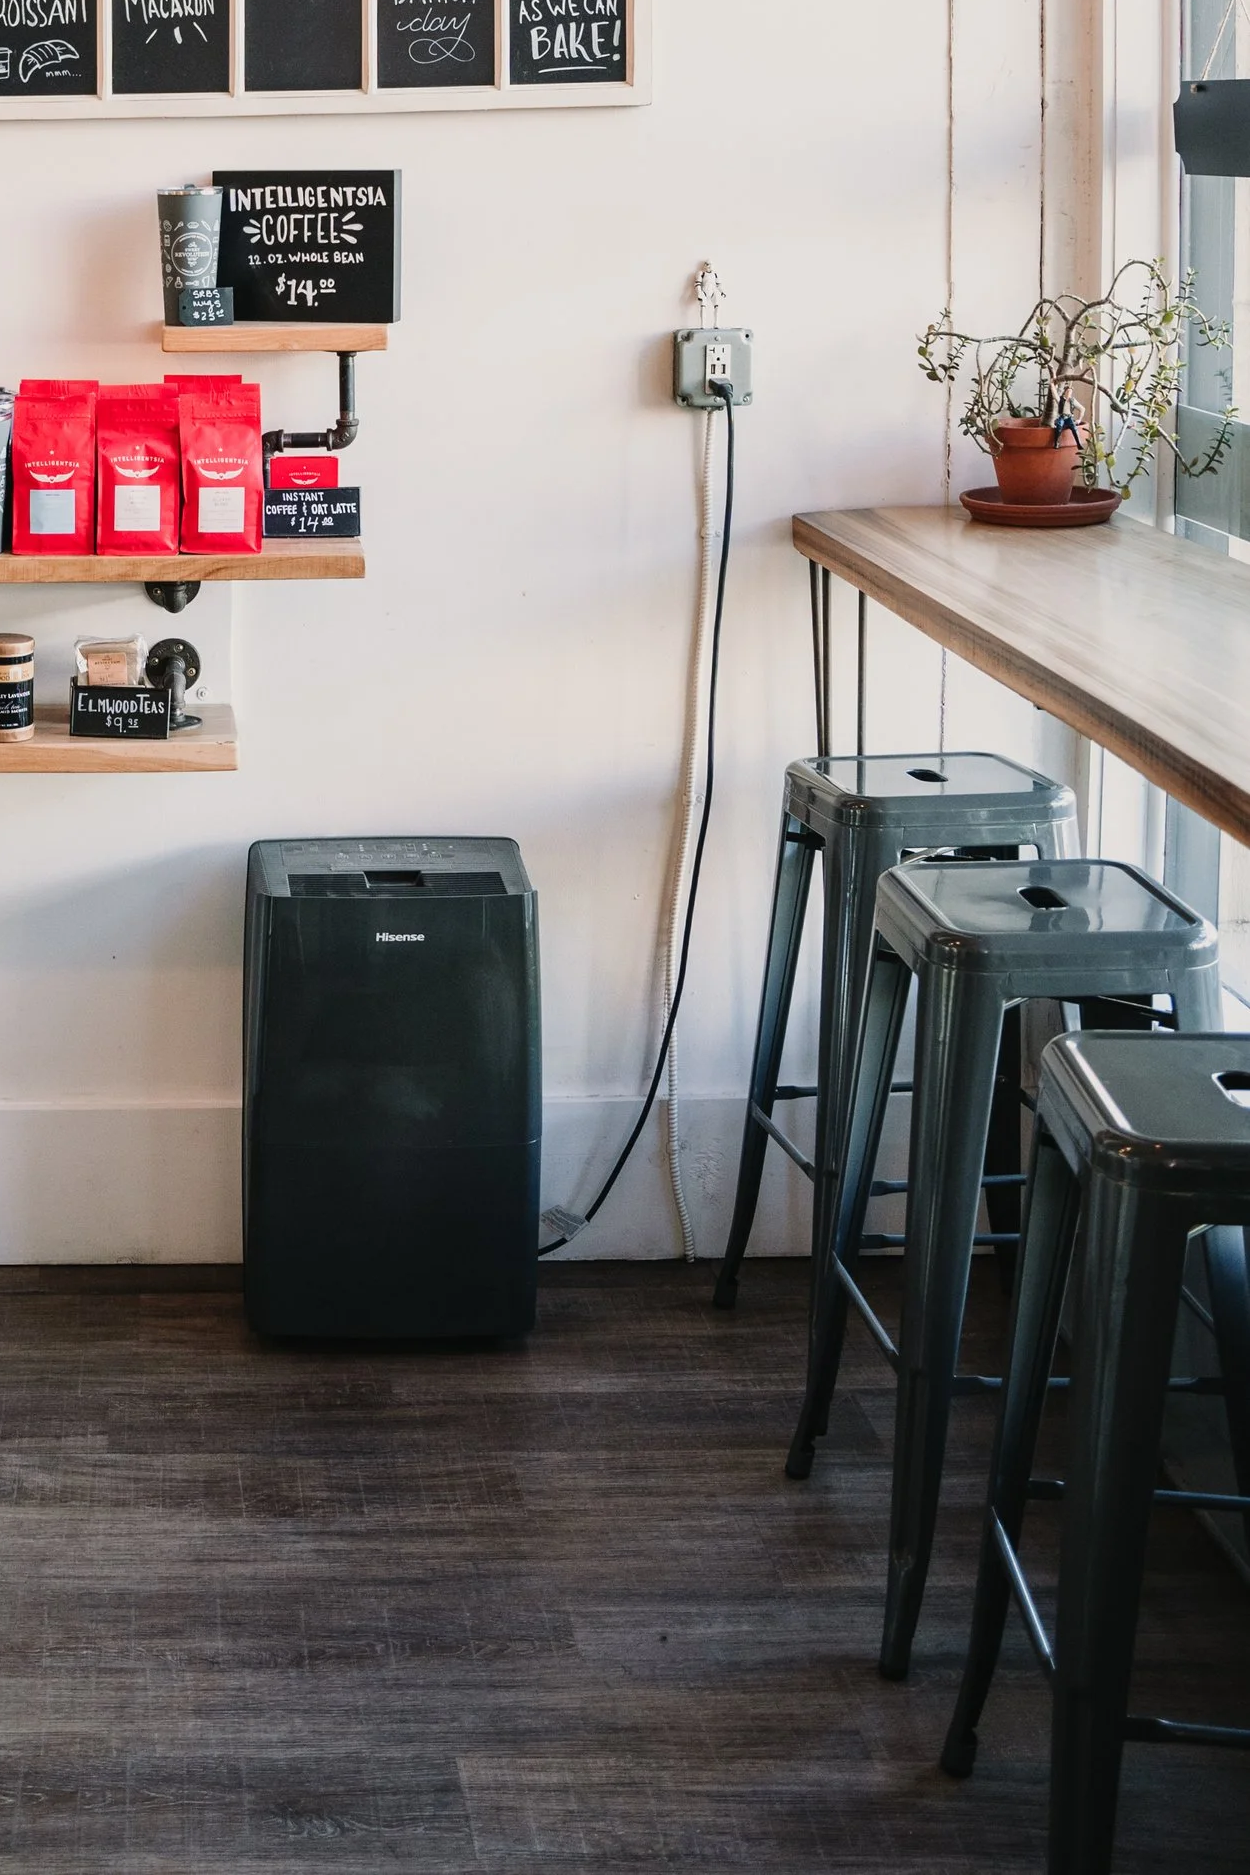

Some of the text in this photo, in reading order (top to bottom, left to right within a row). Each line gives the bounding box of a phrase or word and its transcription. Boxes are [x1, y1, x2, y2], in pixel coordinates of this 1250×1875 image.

[530, 20, 622, 62] BAKE!
[229, 185, 387, 212] INTELLIGENTSIA
[261, 212, 341, 246] COFFEE
[288, 252, 329, 264] WHOLE
[334, 251, 364, 264] BEAN
[192, 289, 221, 299] SRBS
[282, 491, 325, 502] INSTANT
[265, 504, 298, 515] COFFEE
[311, 503, 329, 515] OAT
[330, 502, 357, 515] LATTE
[77, 692, 165, 714] ELMWOOD TEAS
[375, 931, 425, 943] Hisense
